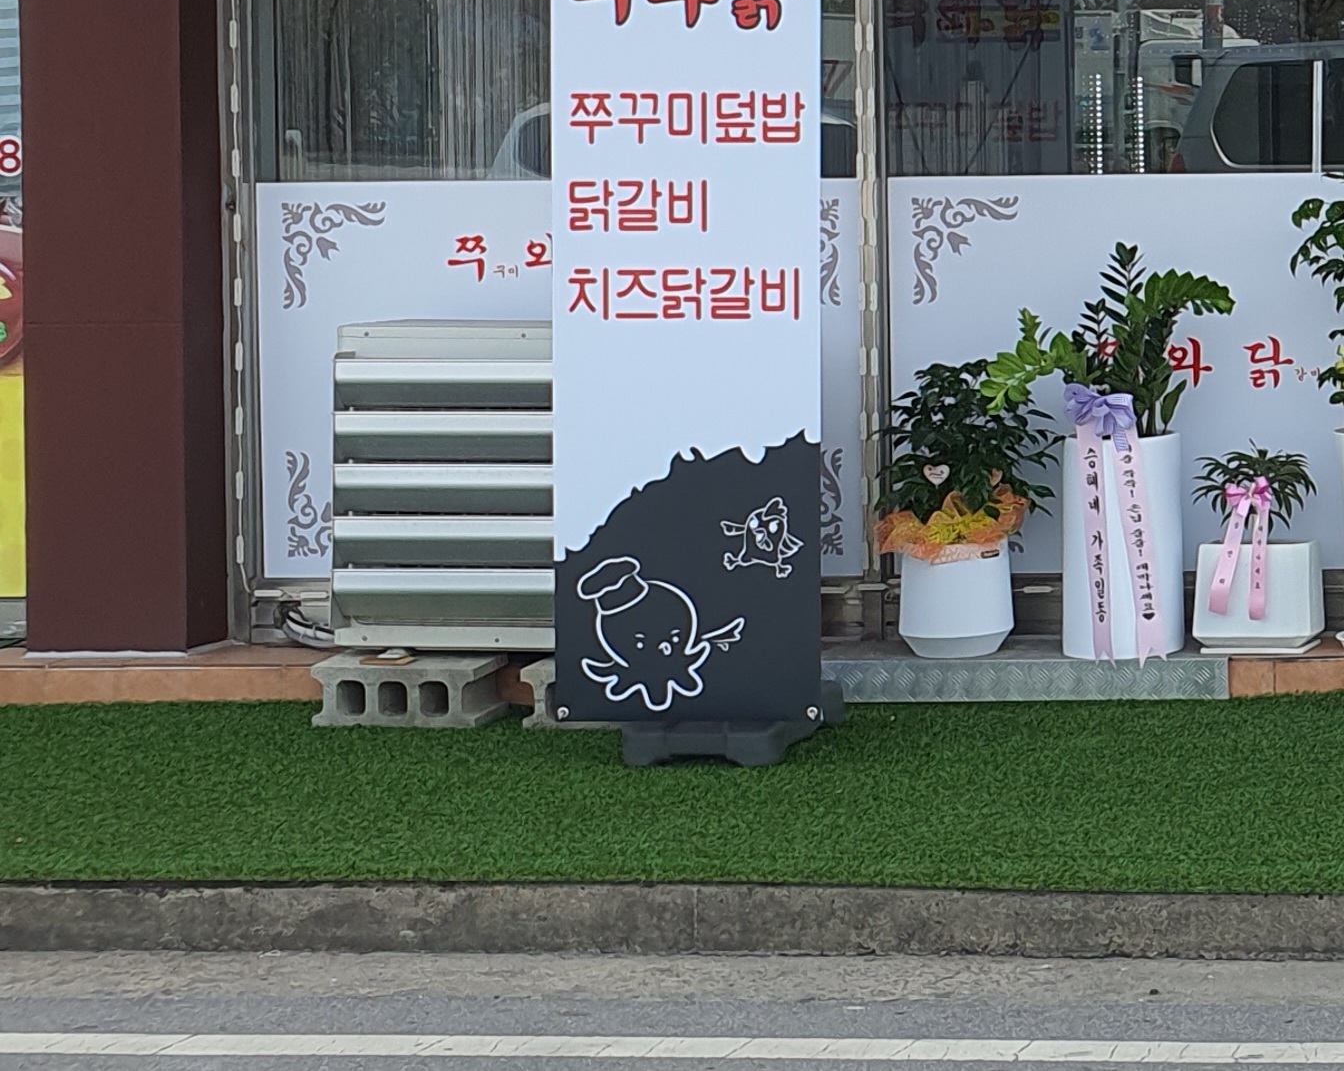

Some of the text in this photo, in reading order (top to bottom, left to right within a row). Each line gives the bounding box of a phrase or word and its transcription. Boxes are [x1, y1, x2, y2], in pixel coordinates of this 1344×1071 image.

[568, 90, 806, 145] 쭈꾸미덮밥
[568, 178, 709, 233] 닭갈비
[567, 266, 801, 321] 치즈닭갈비
[1090, 530, 1108, 624] 가족일동
